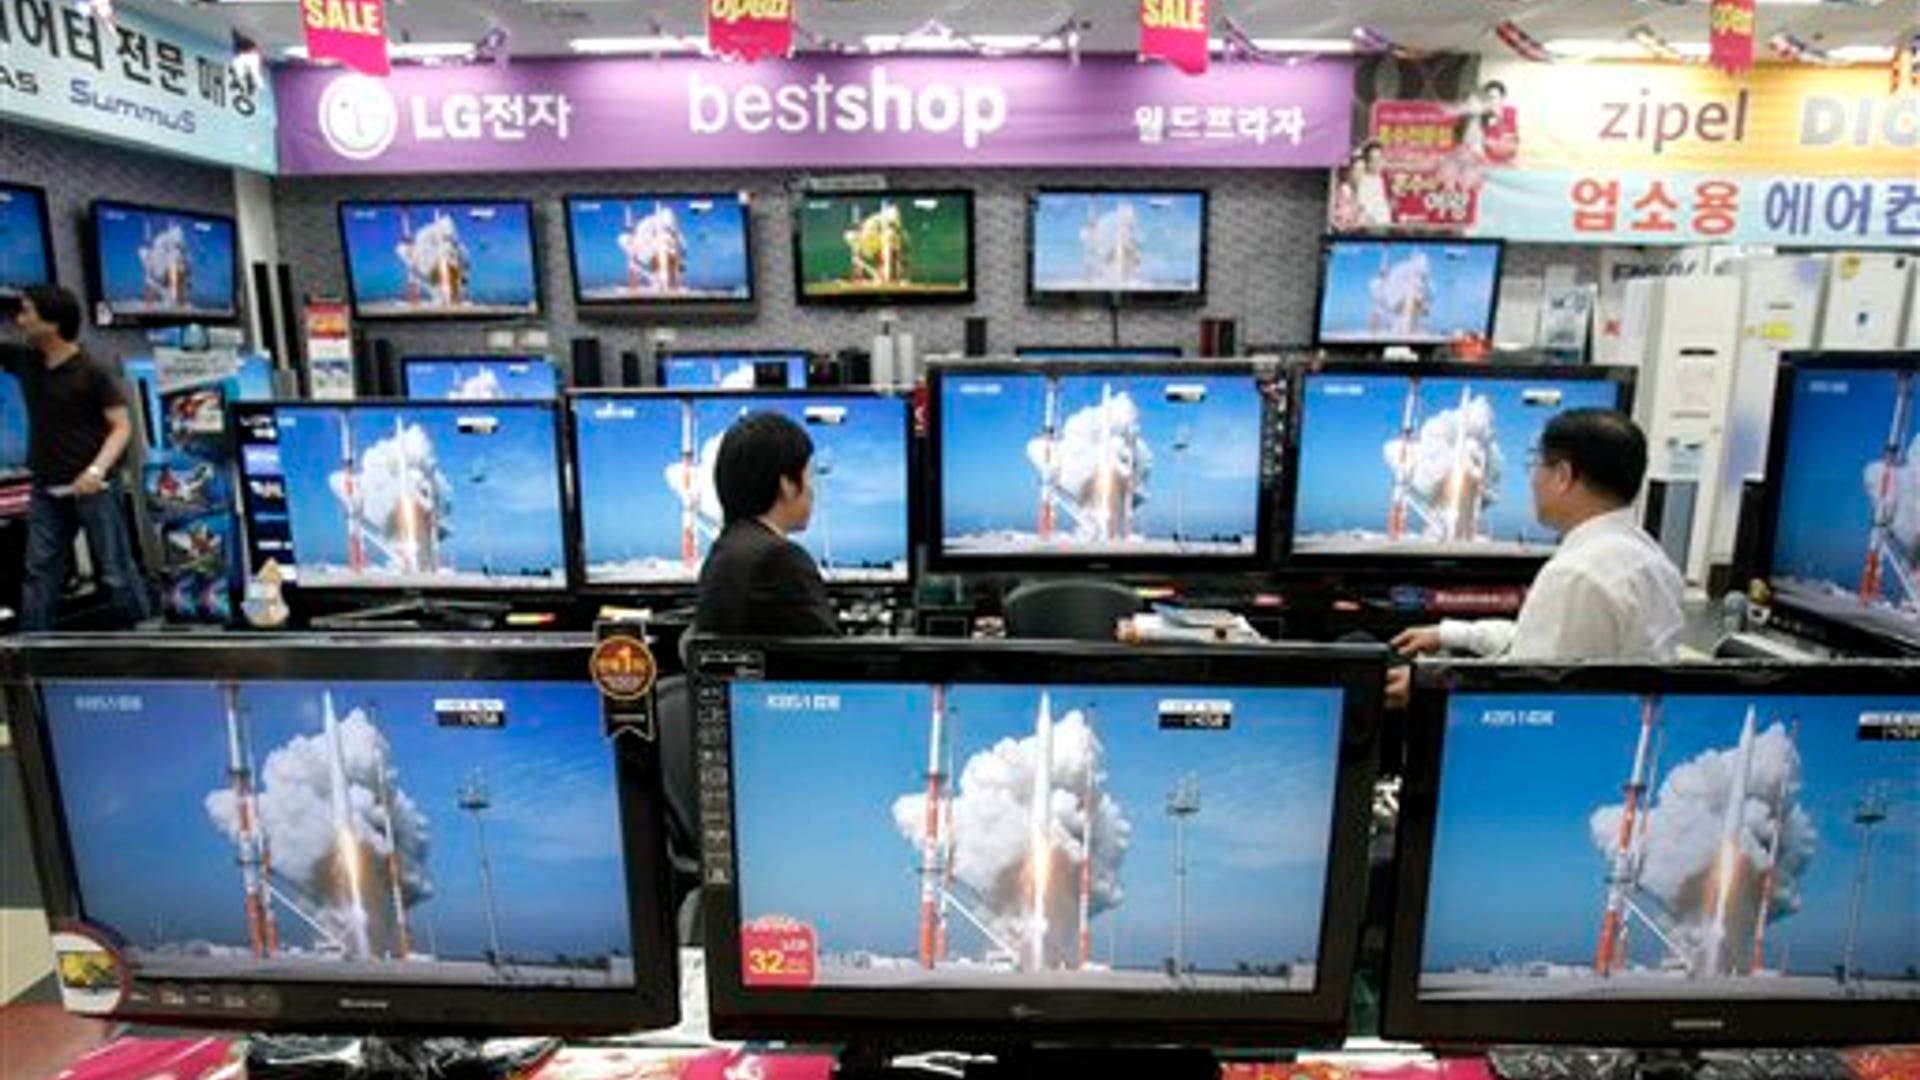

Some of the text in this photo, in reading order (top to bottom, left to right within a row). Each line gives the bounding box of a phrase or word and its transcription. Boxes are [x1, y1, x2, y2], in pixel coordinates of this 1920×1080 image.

[306, 0, 380, 35] SALE
[1142, 0, 1205, 30] SALE
[116, 25, 187, 96] 전문
[411, 92, 572, 139] LG전자
[688, 65, 1006, 149] bestshop
[1134, 106, 1305, 144] 월드프라자
[1598, 88, 1749, 154] zipel
[1571, 178, 1739, 235] 업소용
[749, 949, 784, 974] 32
